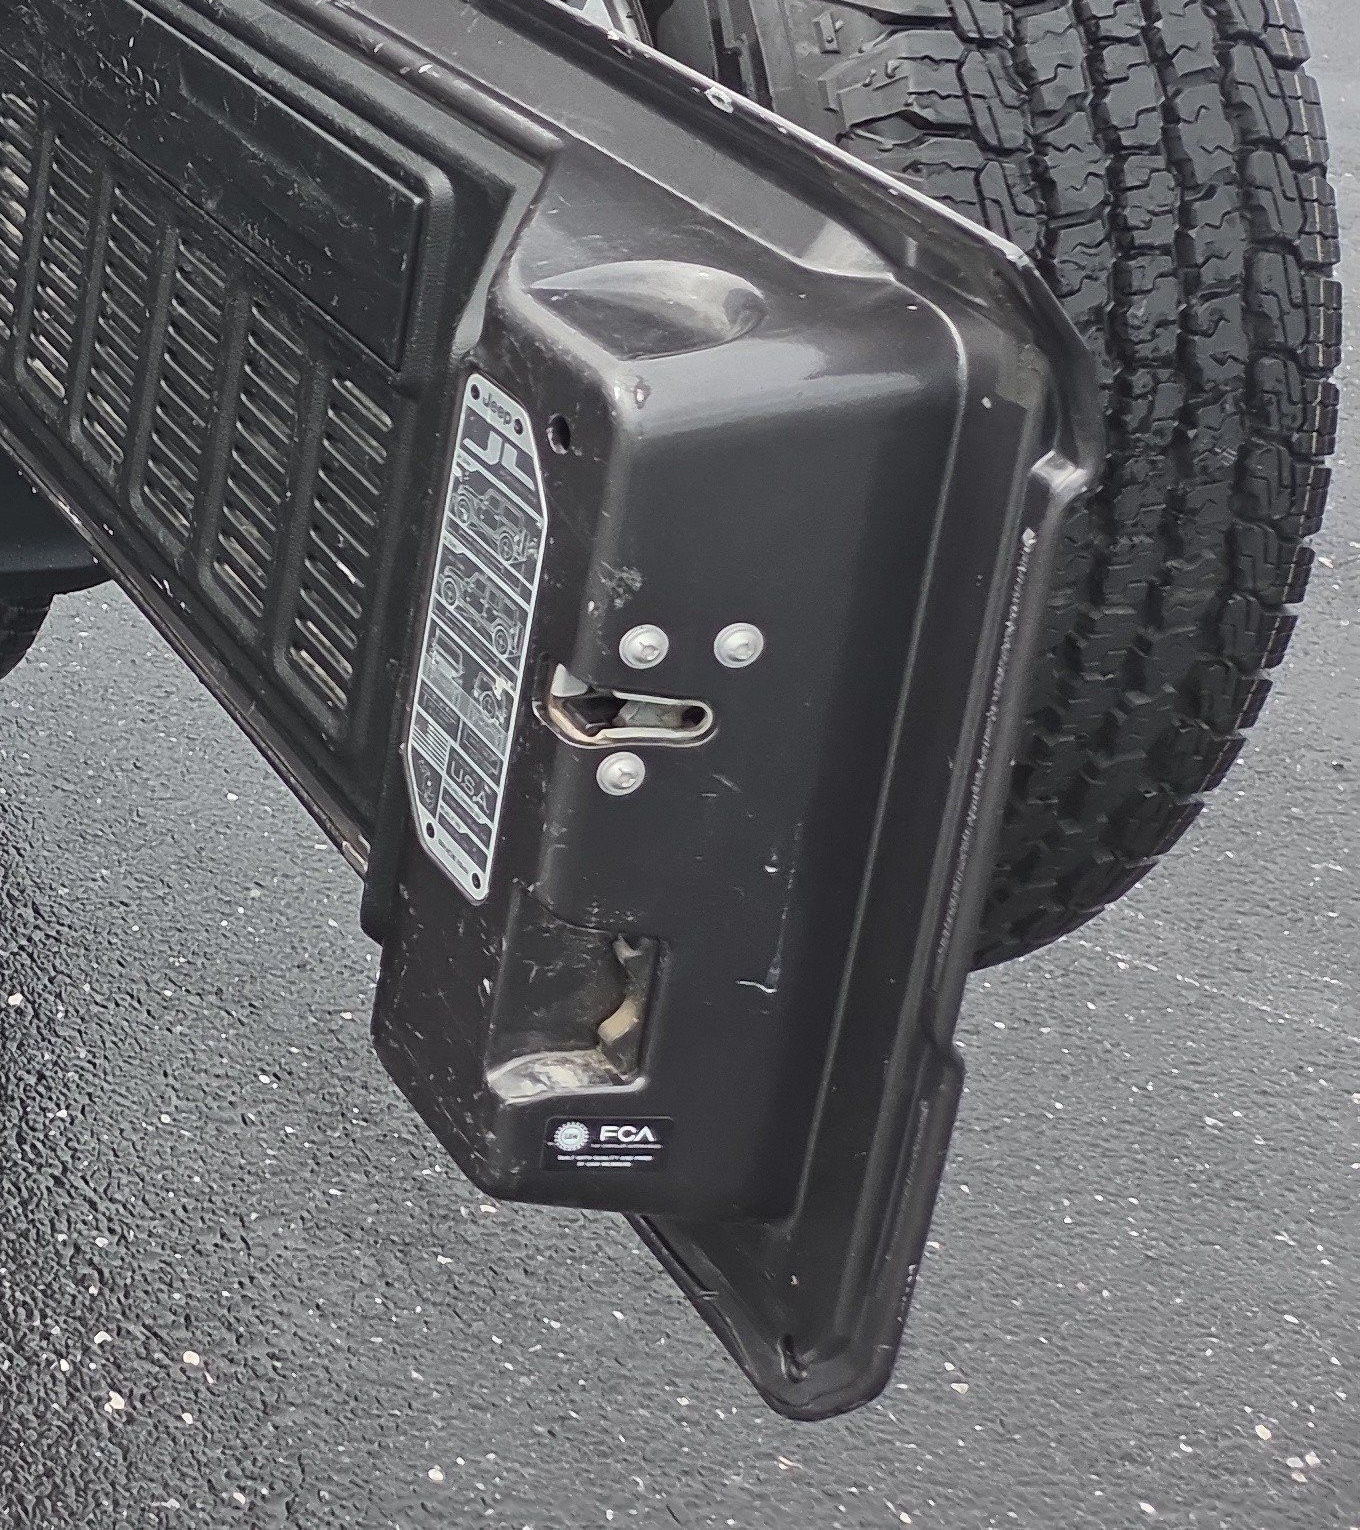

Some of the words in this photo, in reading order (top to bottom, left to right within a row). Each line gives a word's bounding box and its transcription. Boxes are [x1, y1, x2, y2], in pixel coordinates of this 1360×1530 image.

[482, 392, 512, 426] Jeep
[462, 430, 536, 492] JL
[451, 760, 489, 813] USA
[599, 1125, 656, 1143] FCA
